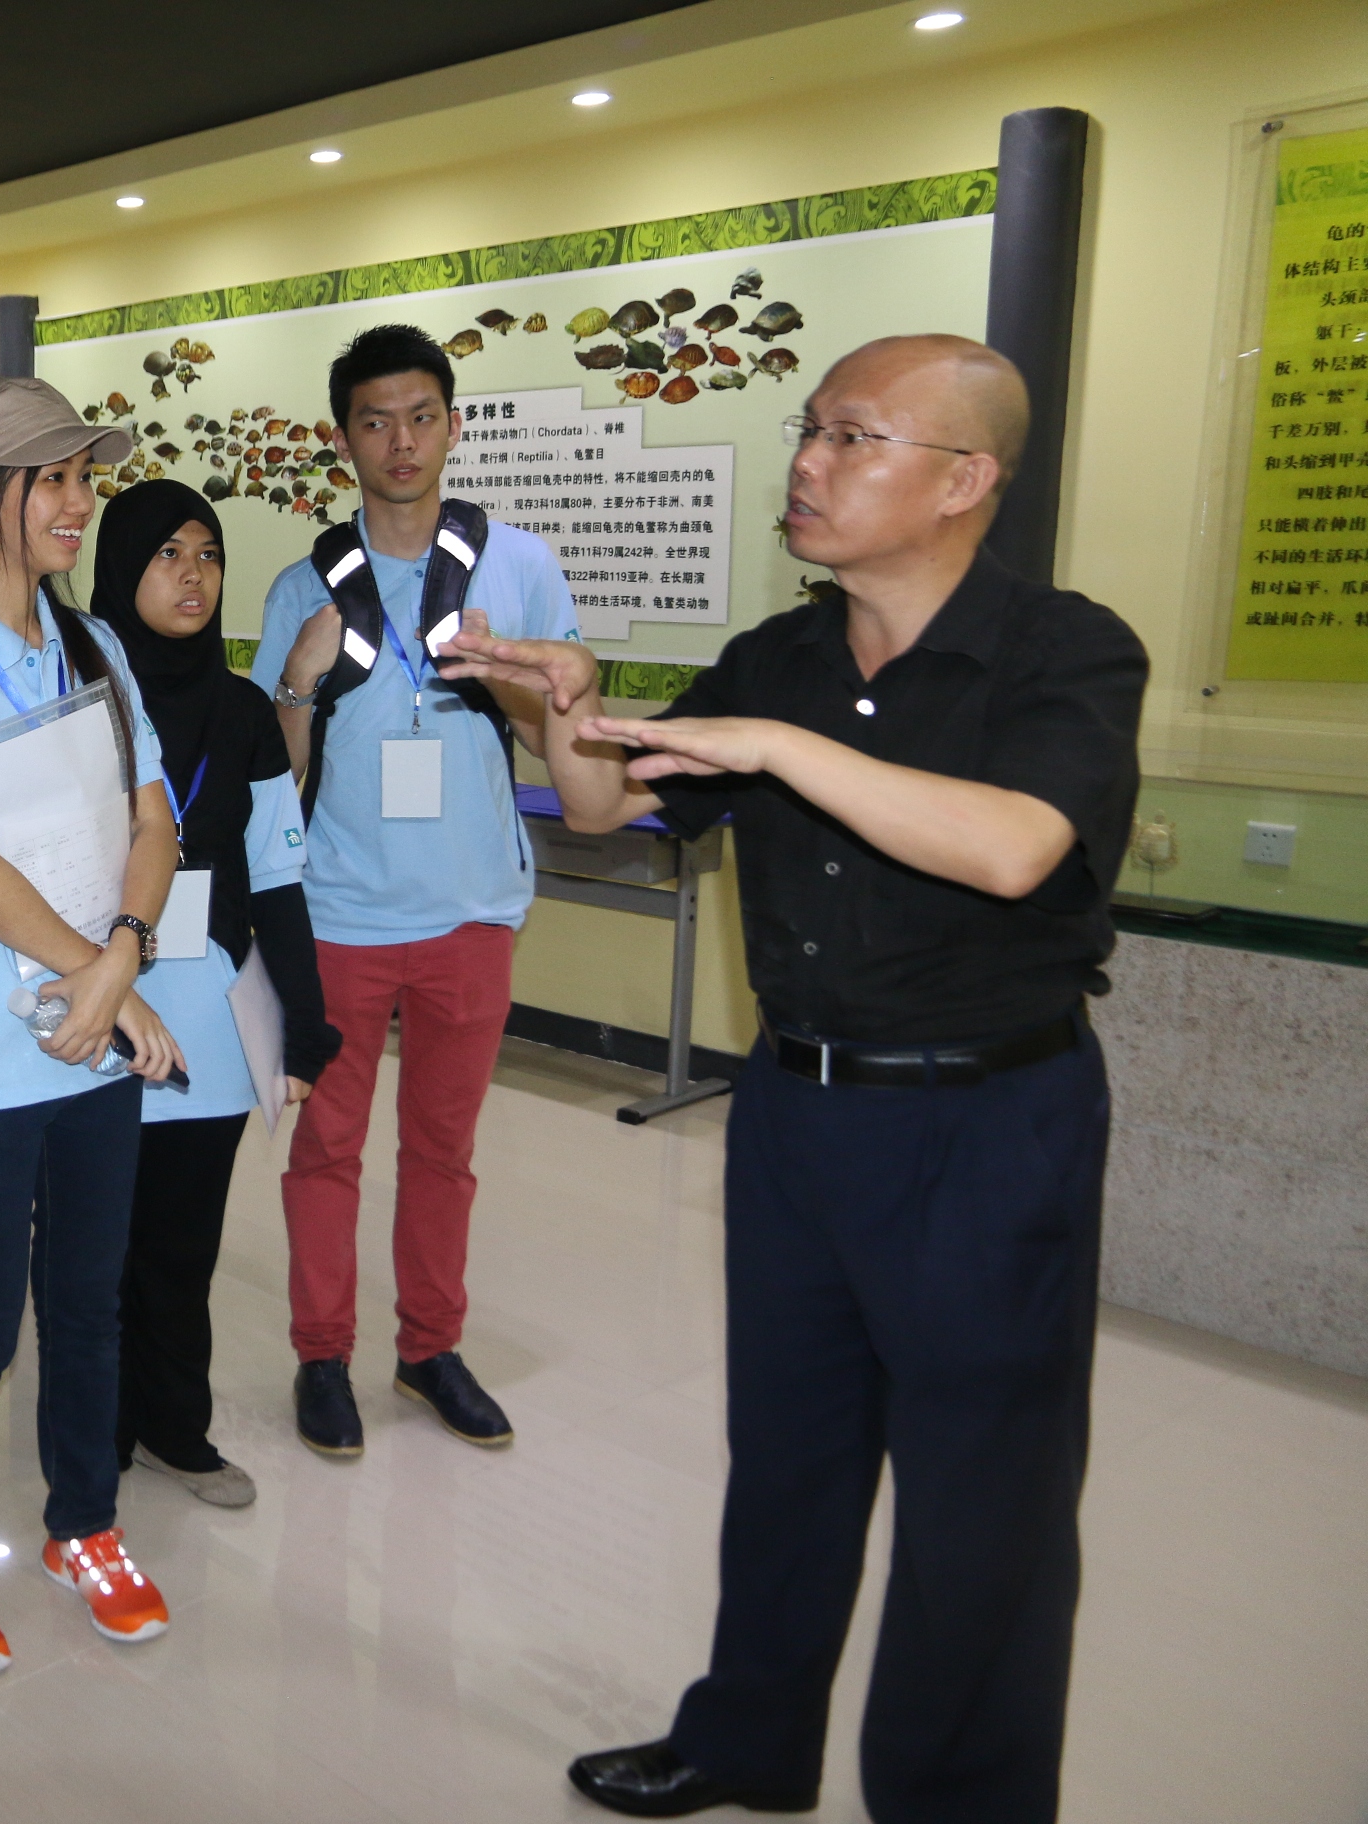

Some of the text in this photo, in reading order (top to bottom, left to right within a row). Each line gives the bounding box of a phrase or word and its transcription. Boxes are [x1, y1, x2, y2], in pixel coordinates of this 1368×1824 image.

[1327, 222, 1368, 241] 龟的
[451, 401, 516, 421] 多样性
[1254, 549, 1368, 564] 不同的生活环
